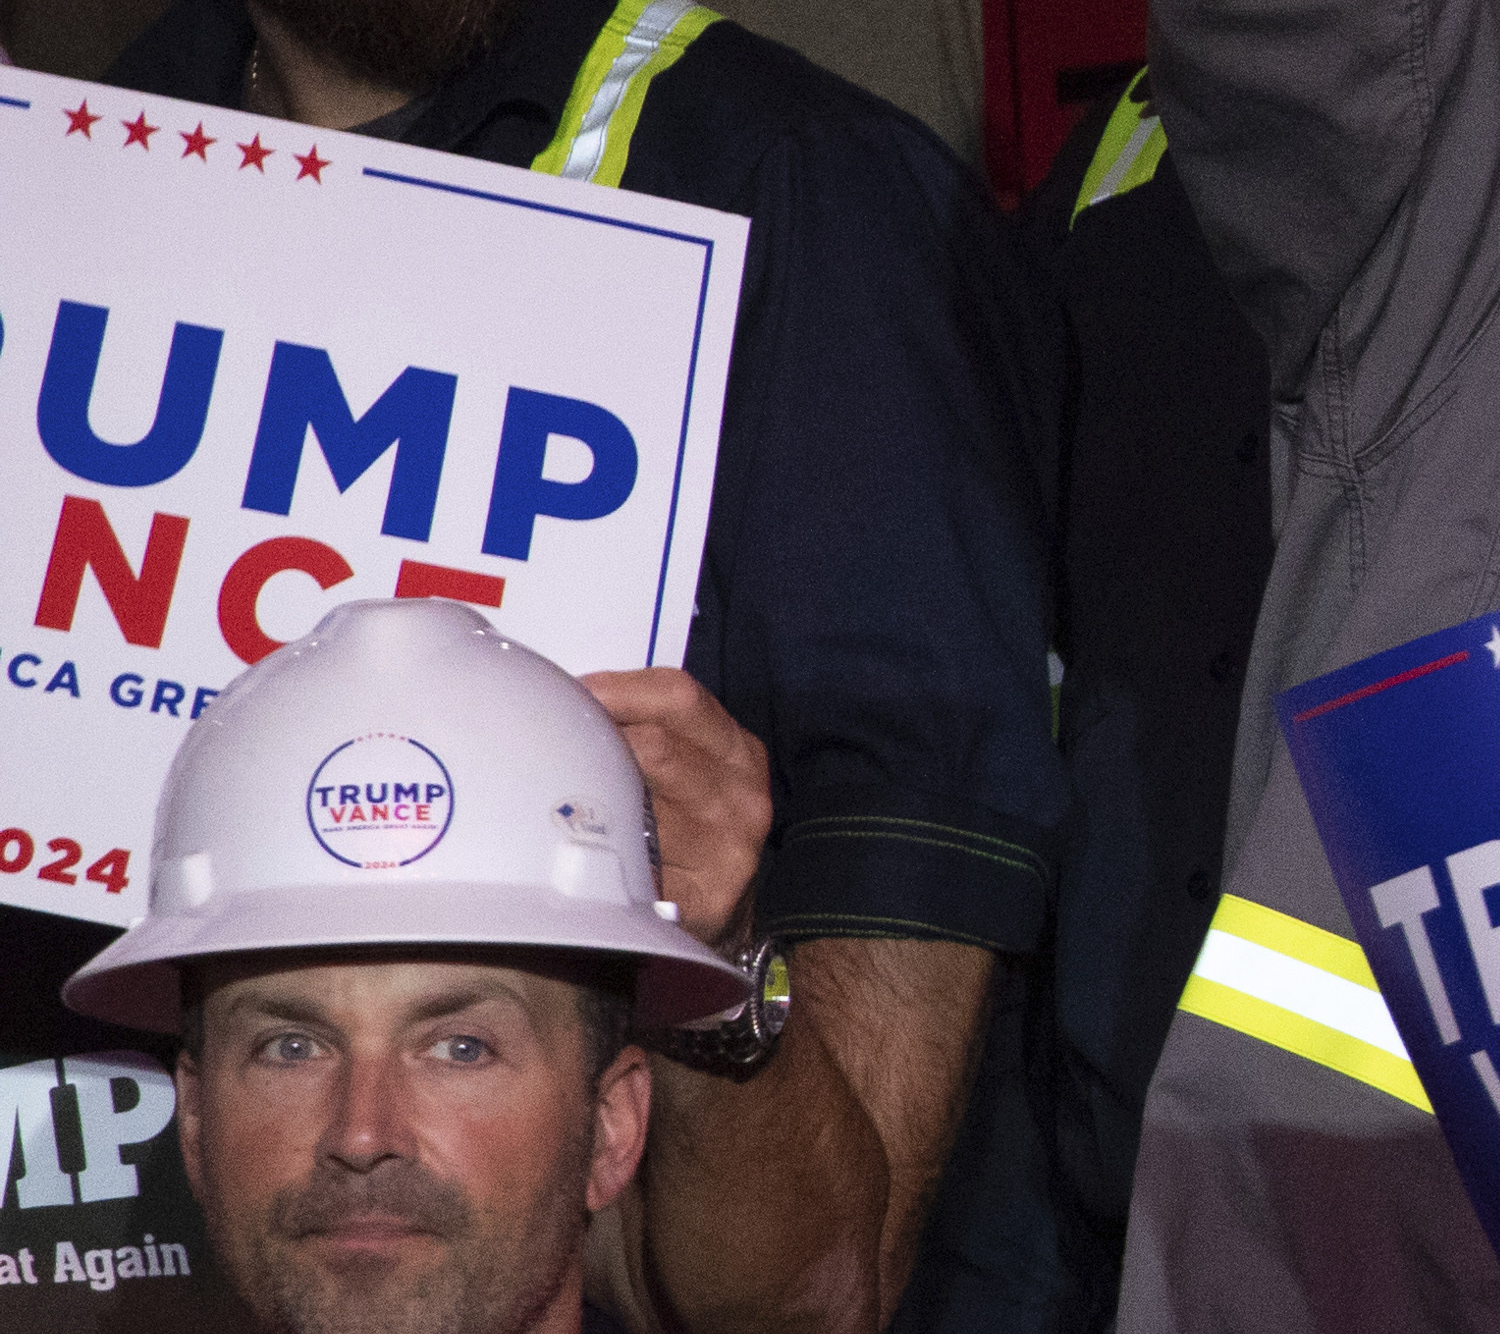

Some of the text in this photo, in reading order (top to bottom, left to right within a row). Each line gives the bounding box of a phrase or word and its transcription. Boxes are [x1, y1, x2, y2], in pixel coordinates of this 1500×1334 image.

[0, 299, 638, 562] UMP
[315, 782, 445, 807] TRUMP
[330, 804, 432, 824] VANCE
[54, 1233, 192, 1292] Again
